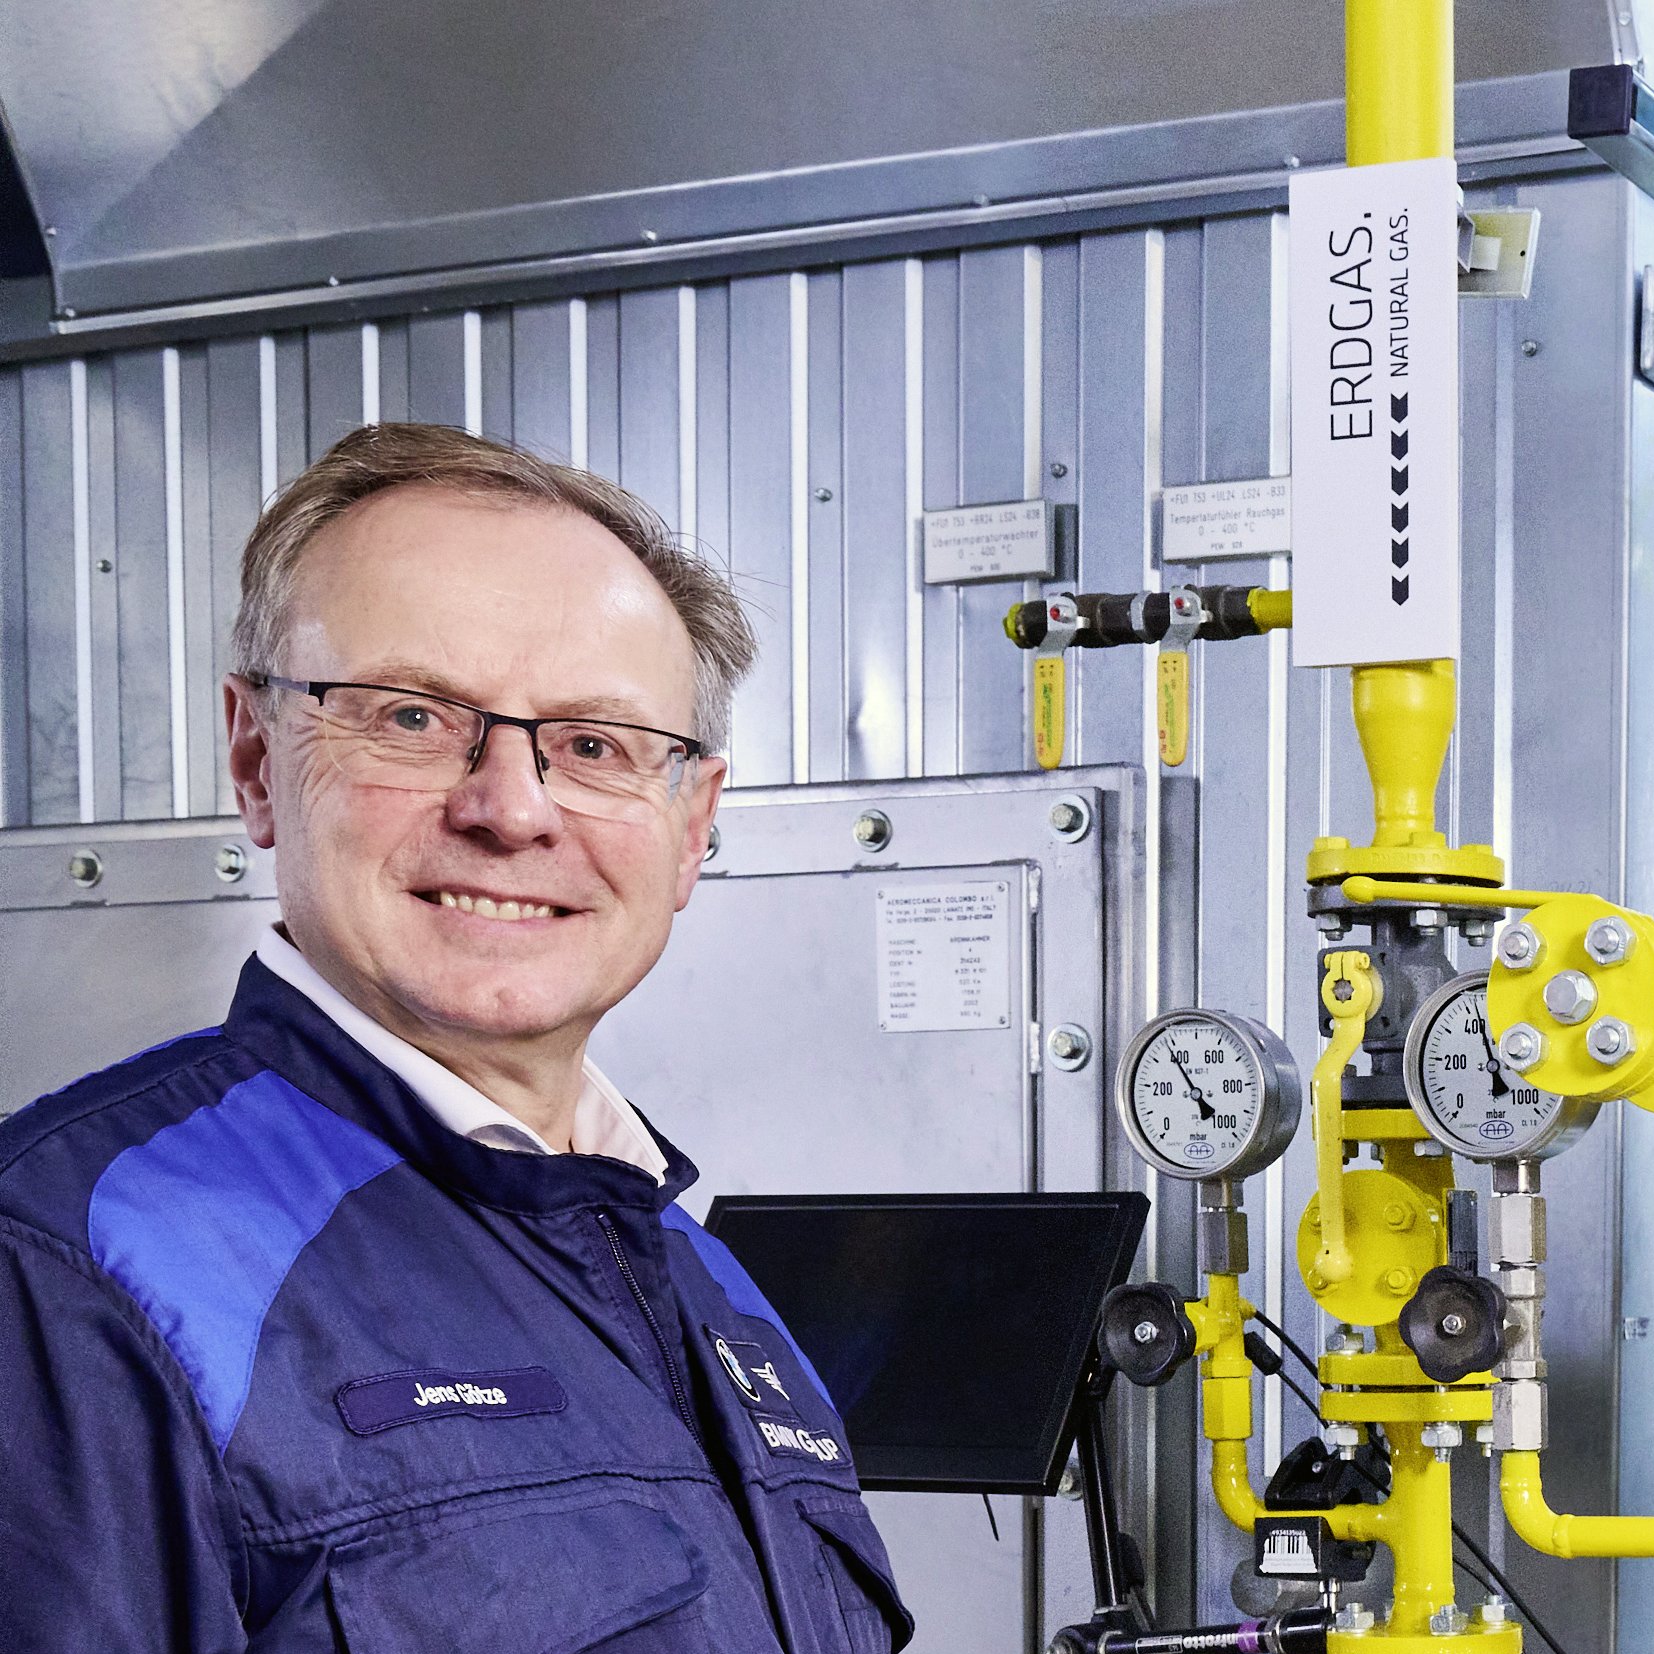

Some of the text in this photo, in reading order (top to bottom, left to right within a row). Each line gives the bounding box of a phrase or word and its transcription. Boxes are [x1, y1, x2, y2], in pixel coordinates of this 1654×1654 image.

[1389, 206, 1409, 377] NATURAL GAS.
[1329, 211, 1373, 441] ERDGAS.
[1222, 523, 1238, 535] 400
[1465, 1019, 1485, 1035] 400
[1170, 1050, 1189, 1064] 400
[1204, 1050, 1224, 1064] 600
[1445, 1054, 1467, 1071] 200
[1153, 1081, 1173, 1096] 200
[1223, 1079, 1242, 1094] 800
[1457, 1093, 1463, 1109] 0
[1510, 1088, 1539, 1105] 1000
[1486, 1108, 1506, 1119] mbar
[1164, 1117, 1170, 1131] 0
[1212, 1114, 1236, 1129] 1000
[1189, 1132, 1207, 1141] mbar
[414, 1382, 460, 1406] Jens
